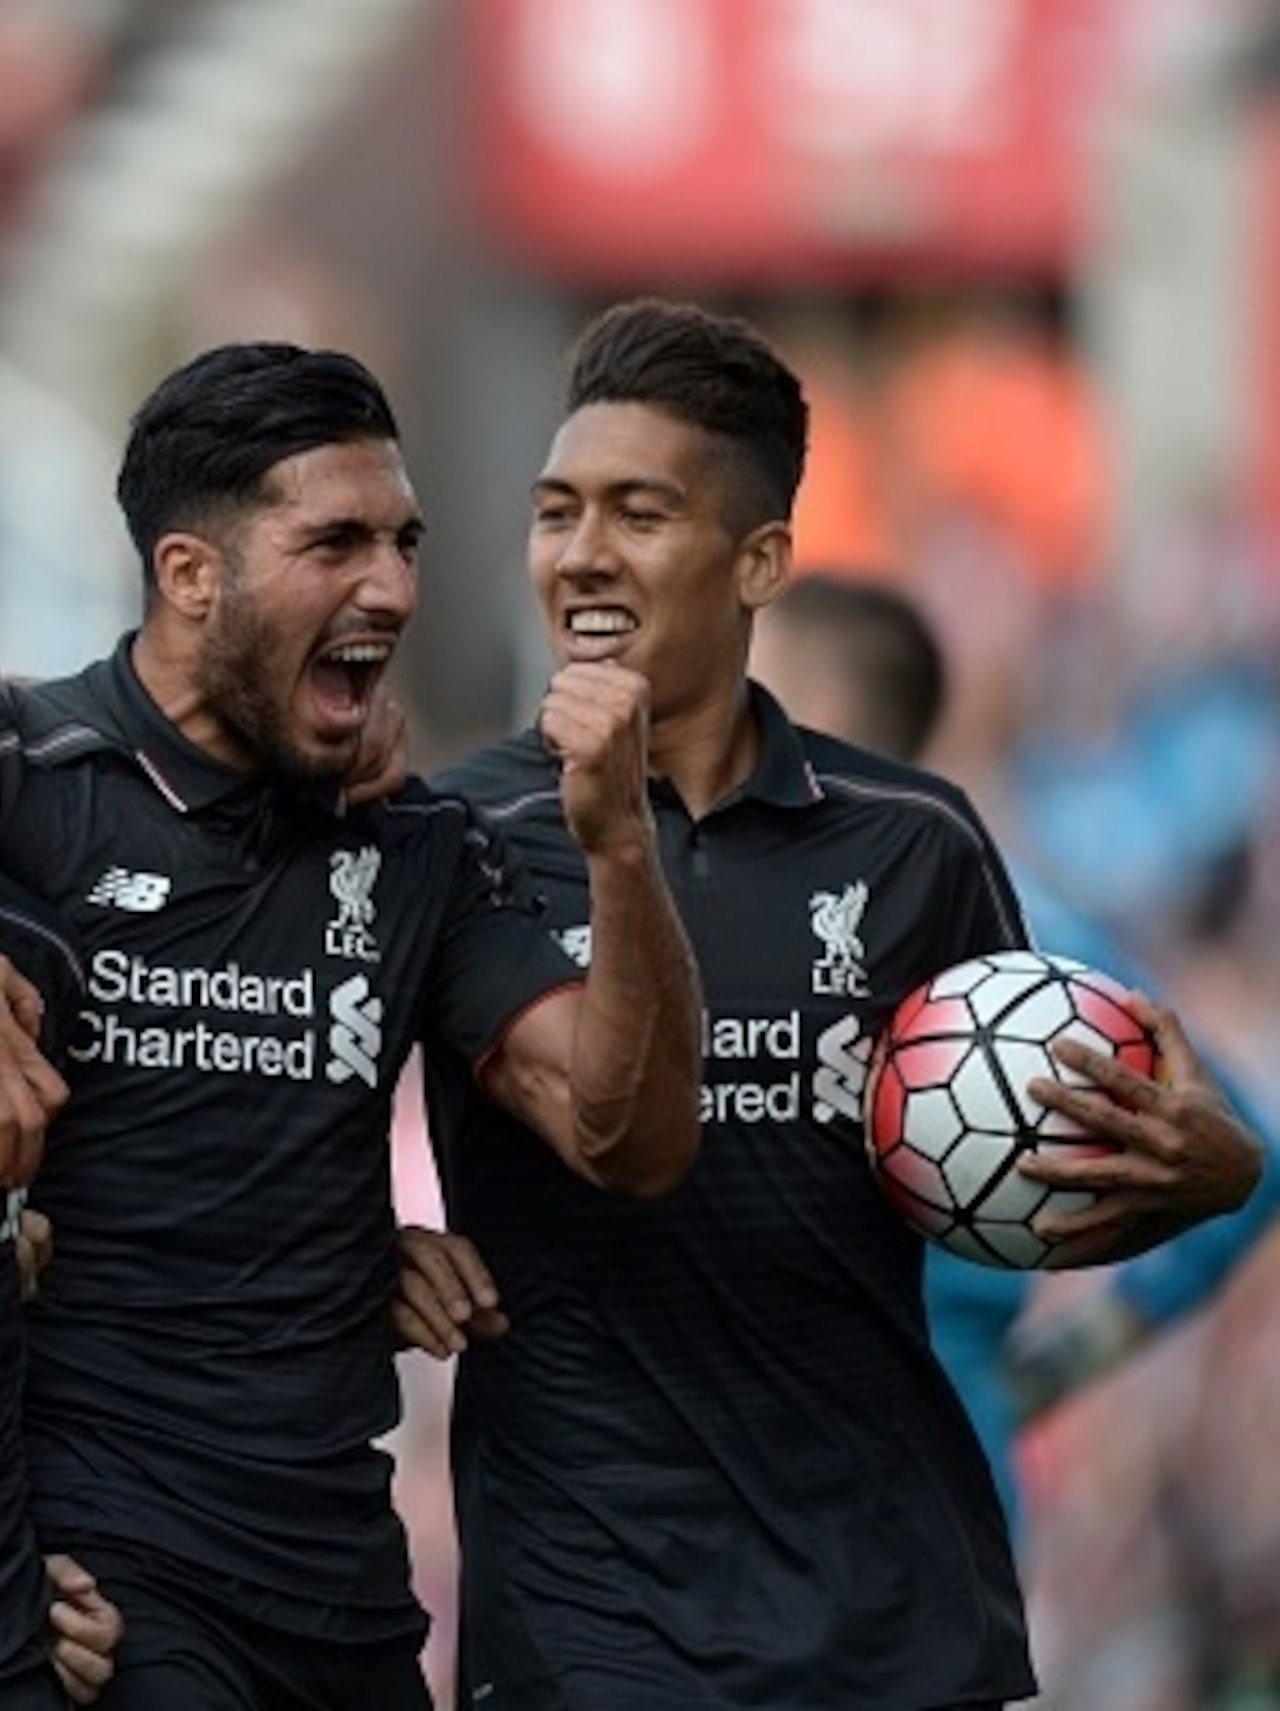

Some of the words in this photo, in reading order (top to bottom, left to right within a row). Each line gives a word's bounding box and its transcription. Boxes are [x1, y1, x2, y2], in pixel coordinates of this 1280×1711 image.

[86, 866, 171, 912] NB
[88, 949, 314, 1018] Standard
[811, 967, 871, 998] LFC
[68, 1010, 314, 1080] Chartered
